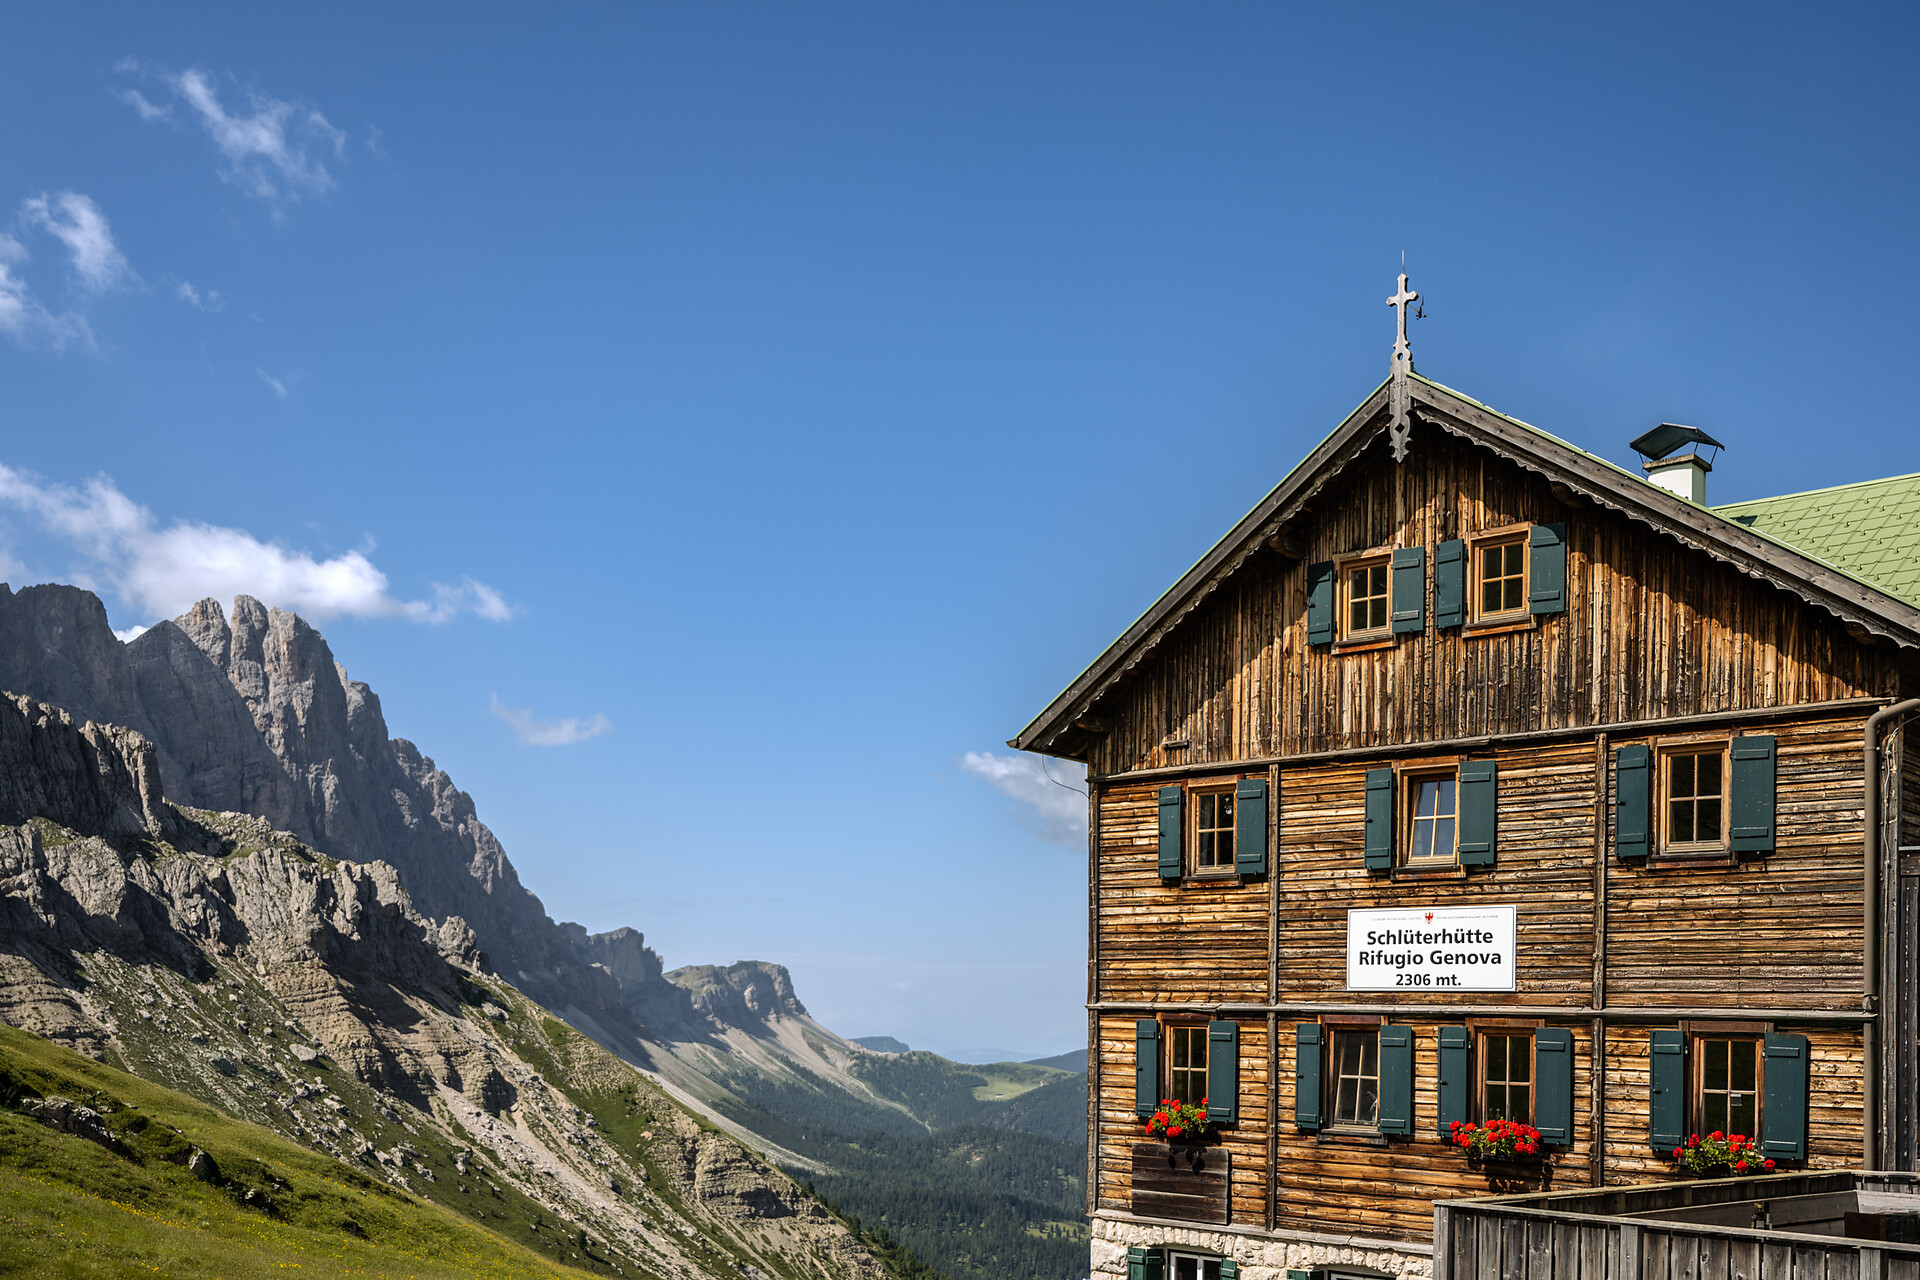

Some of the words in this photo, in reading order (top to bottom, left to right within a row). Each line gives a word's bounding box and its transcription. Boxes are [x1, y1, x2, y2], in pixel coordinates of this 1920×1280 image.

[1367, 928, 1494, 945] Schlüterhütte
[1359, 950, 1424, 969] Rifugio
[1430, 950, 1502, 965] Genova
[1395, 973, 1431, 986] 2306
[1436, 973, 1462, 986] mt.
